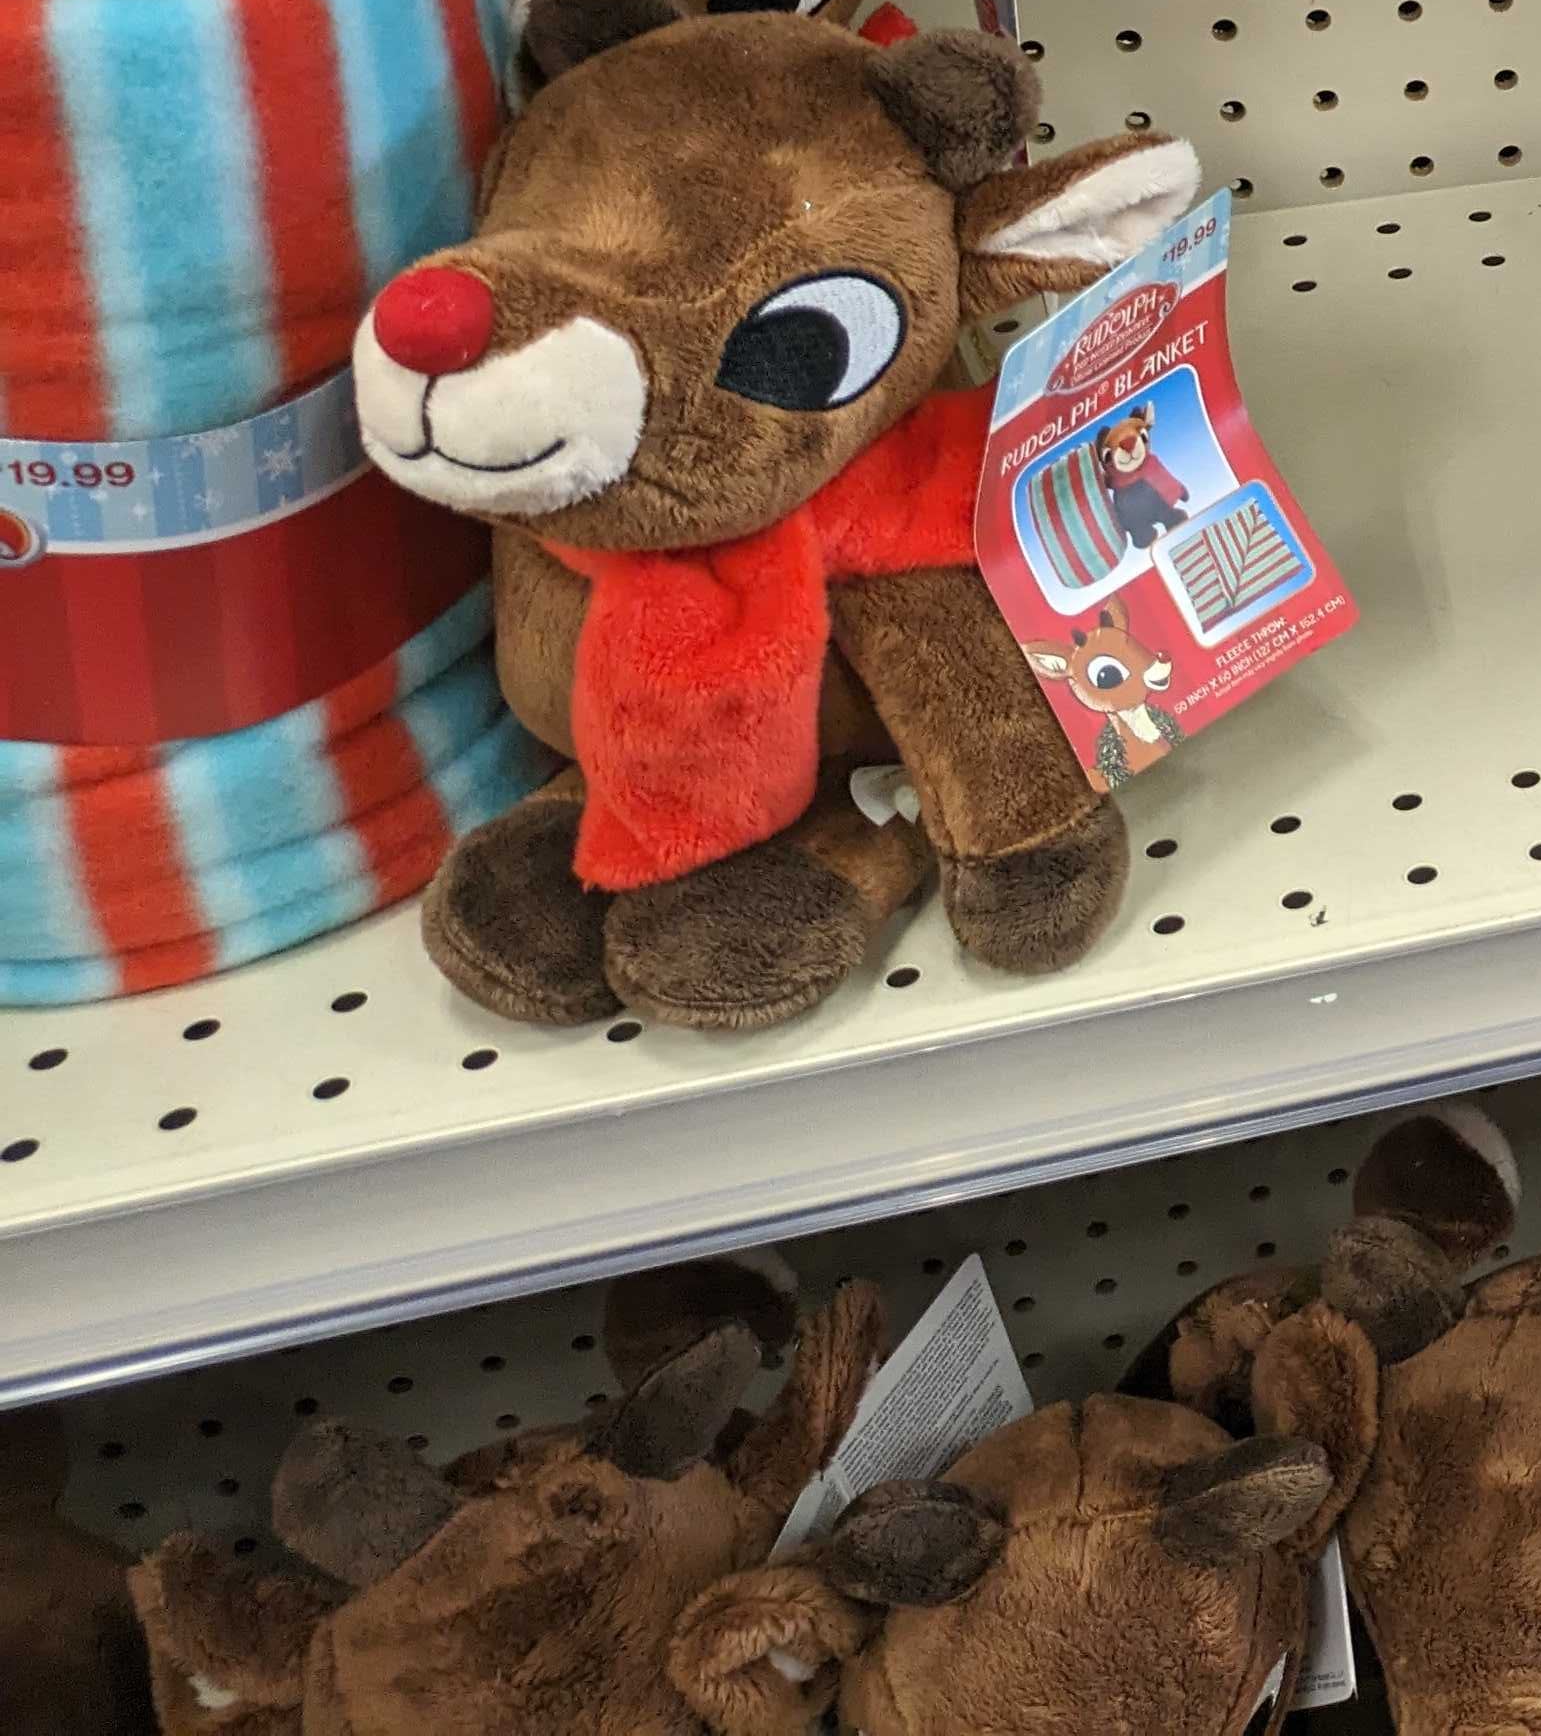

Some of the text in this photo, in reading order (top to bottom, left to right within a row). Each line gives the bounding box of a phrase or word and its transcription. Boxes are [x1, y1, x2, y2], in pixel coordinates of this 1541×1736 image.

[1072, 287, 1159, 363] RUDOLPH
[1113, 320, 1210, 398] BLANKET
[1215, 638, 1252, 669] FLEECE
